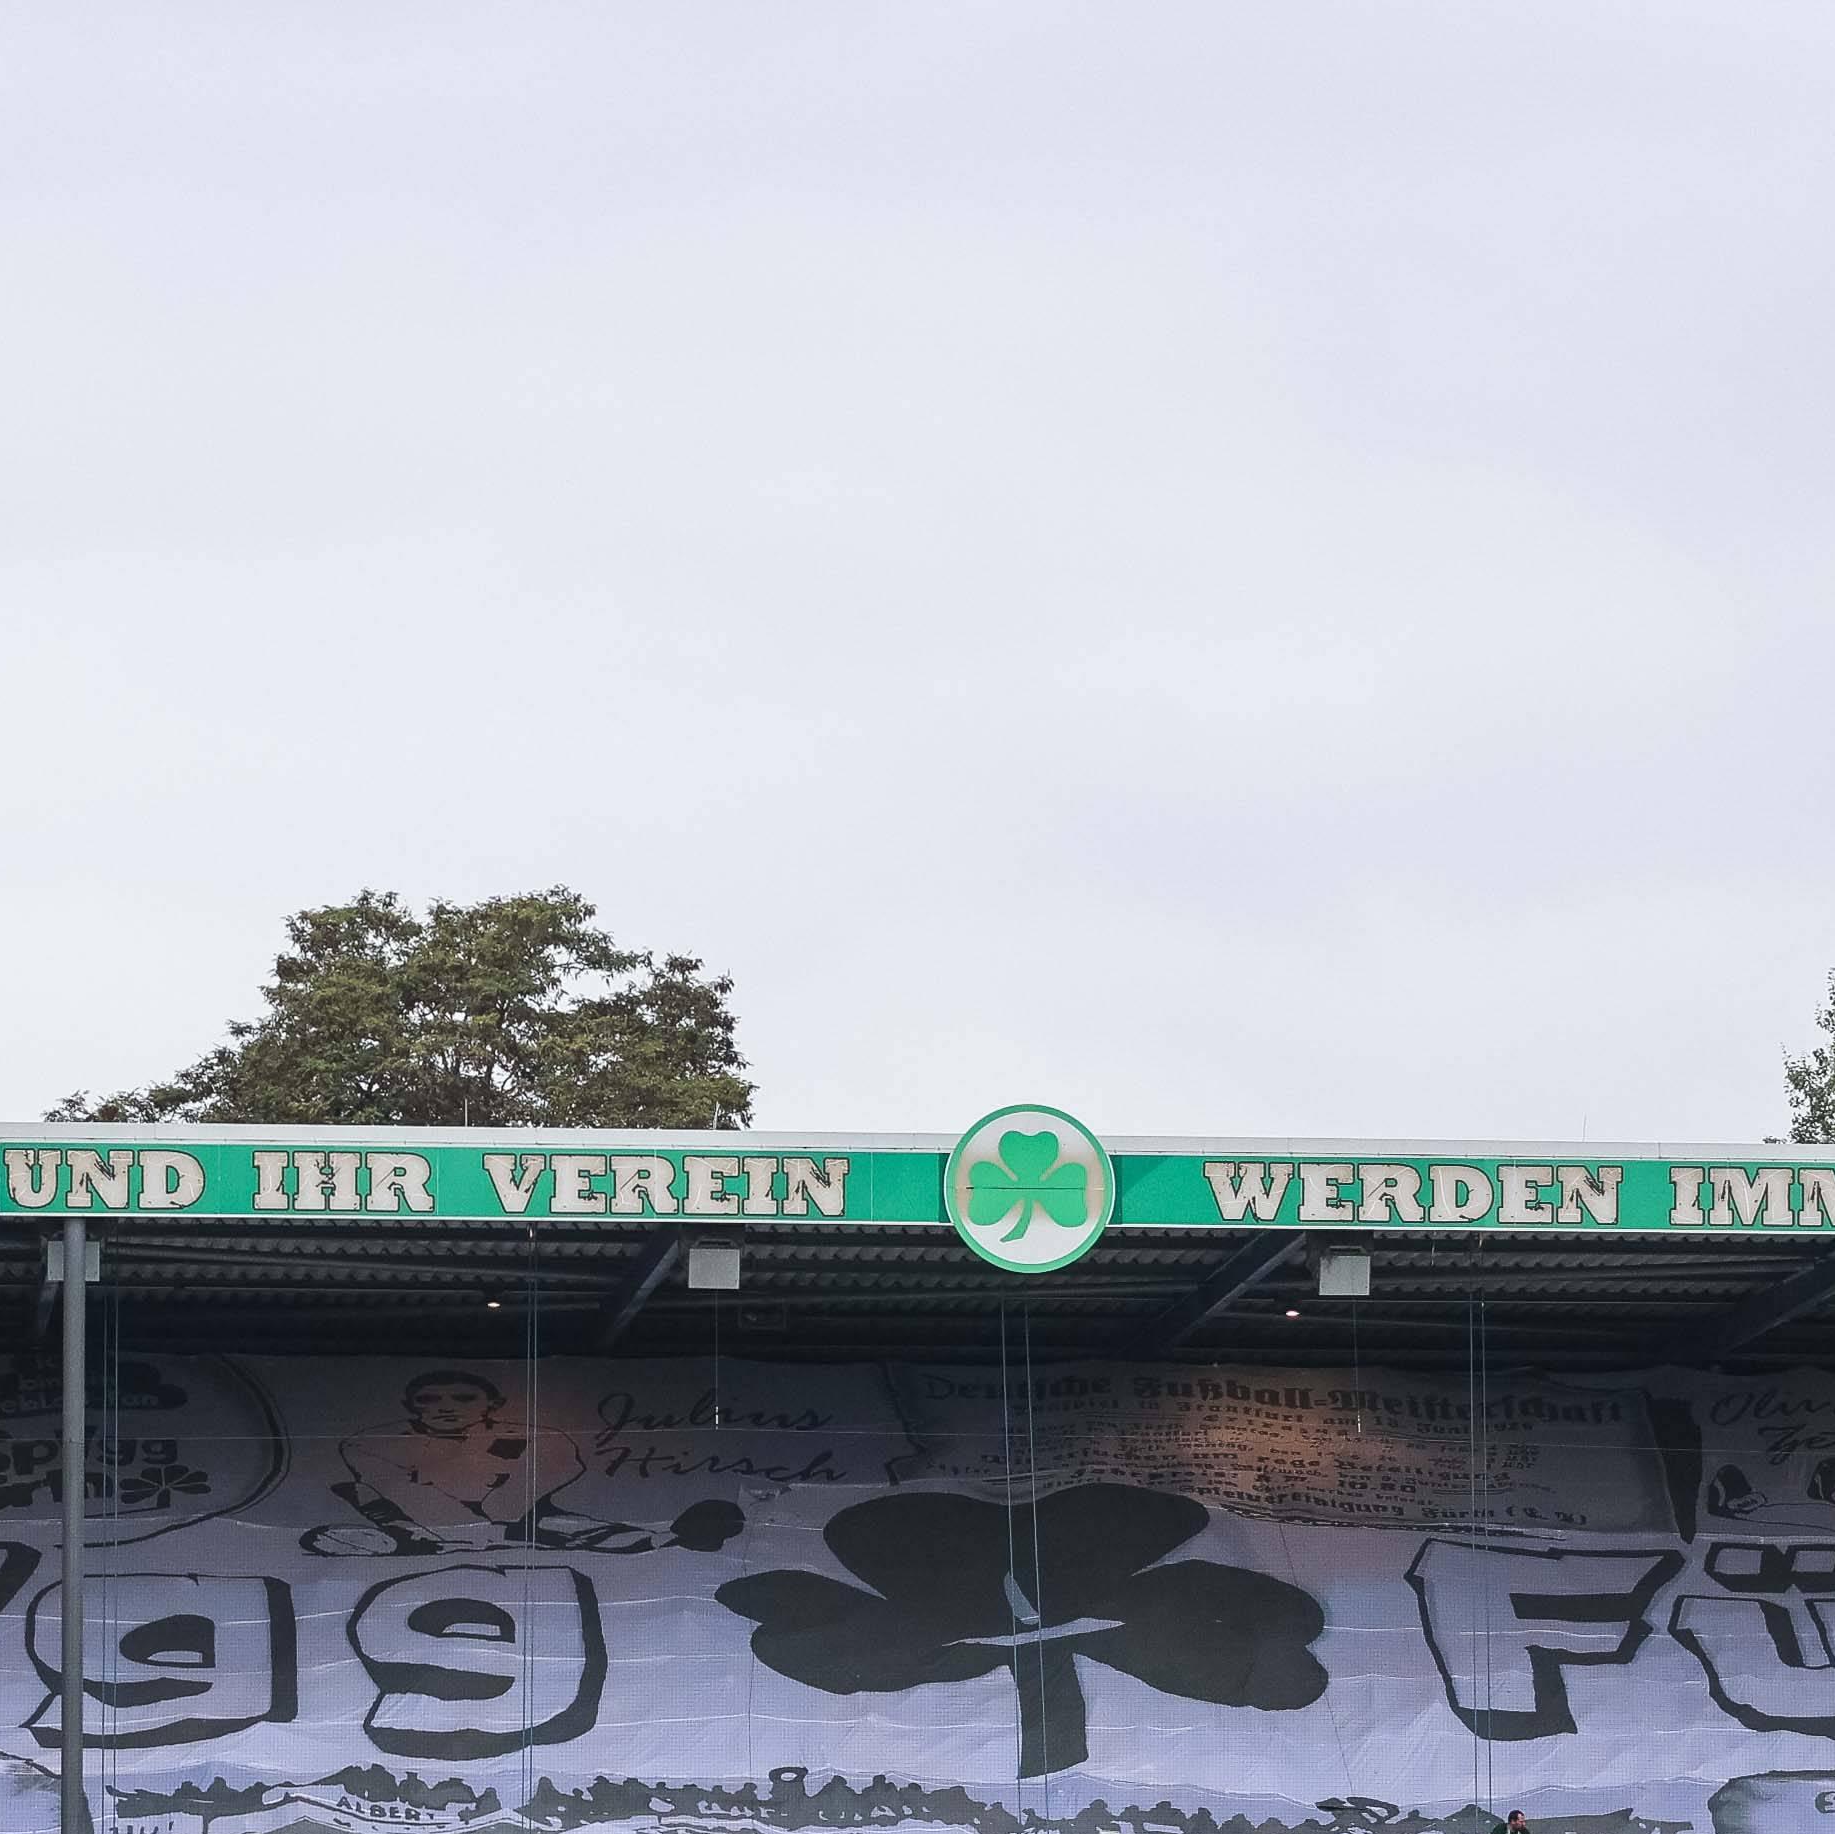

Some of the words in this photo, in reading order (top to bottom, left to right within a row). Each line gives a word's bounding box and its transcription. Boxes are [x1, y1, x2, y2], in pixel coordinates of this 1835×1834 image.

[3, 1148, 206, 1210] UND
[252, 1150, 436, 1213] IHR
[483, 1151, 851, 1217] VEREIN
[1202, 1161, 1624, 1226] WERDEN
[594, 1389, 835, 1442] Julius
[594, 1443, 847, 1483] Hirsch
